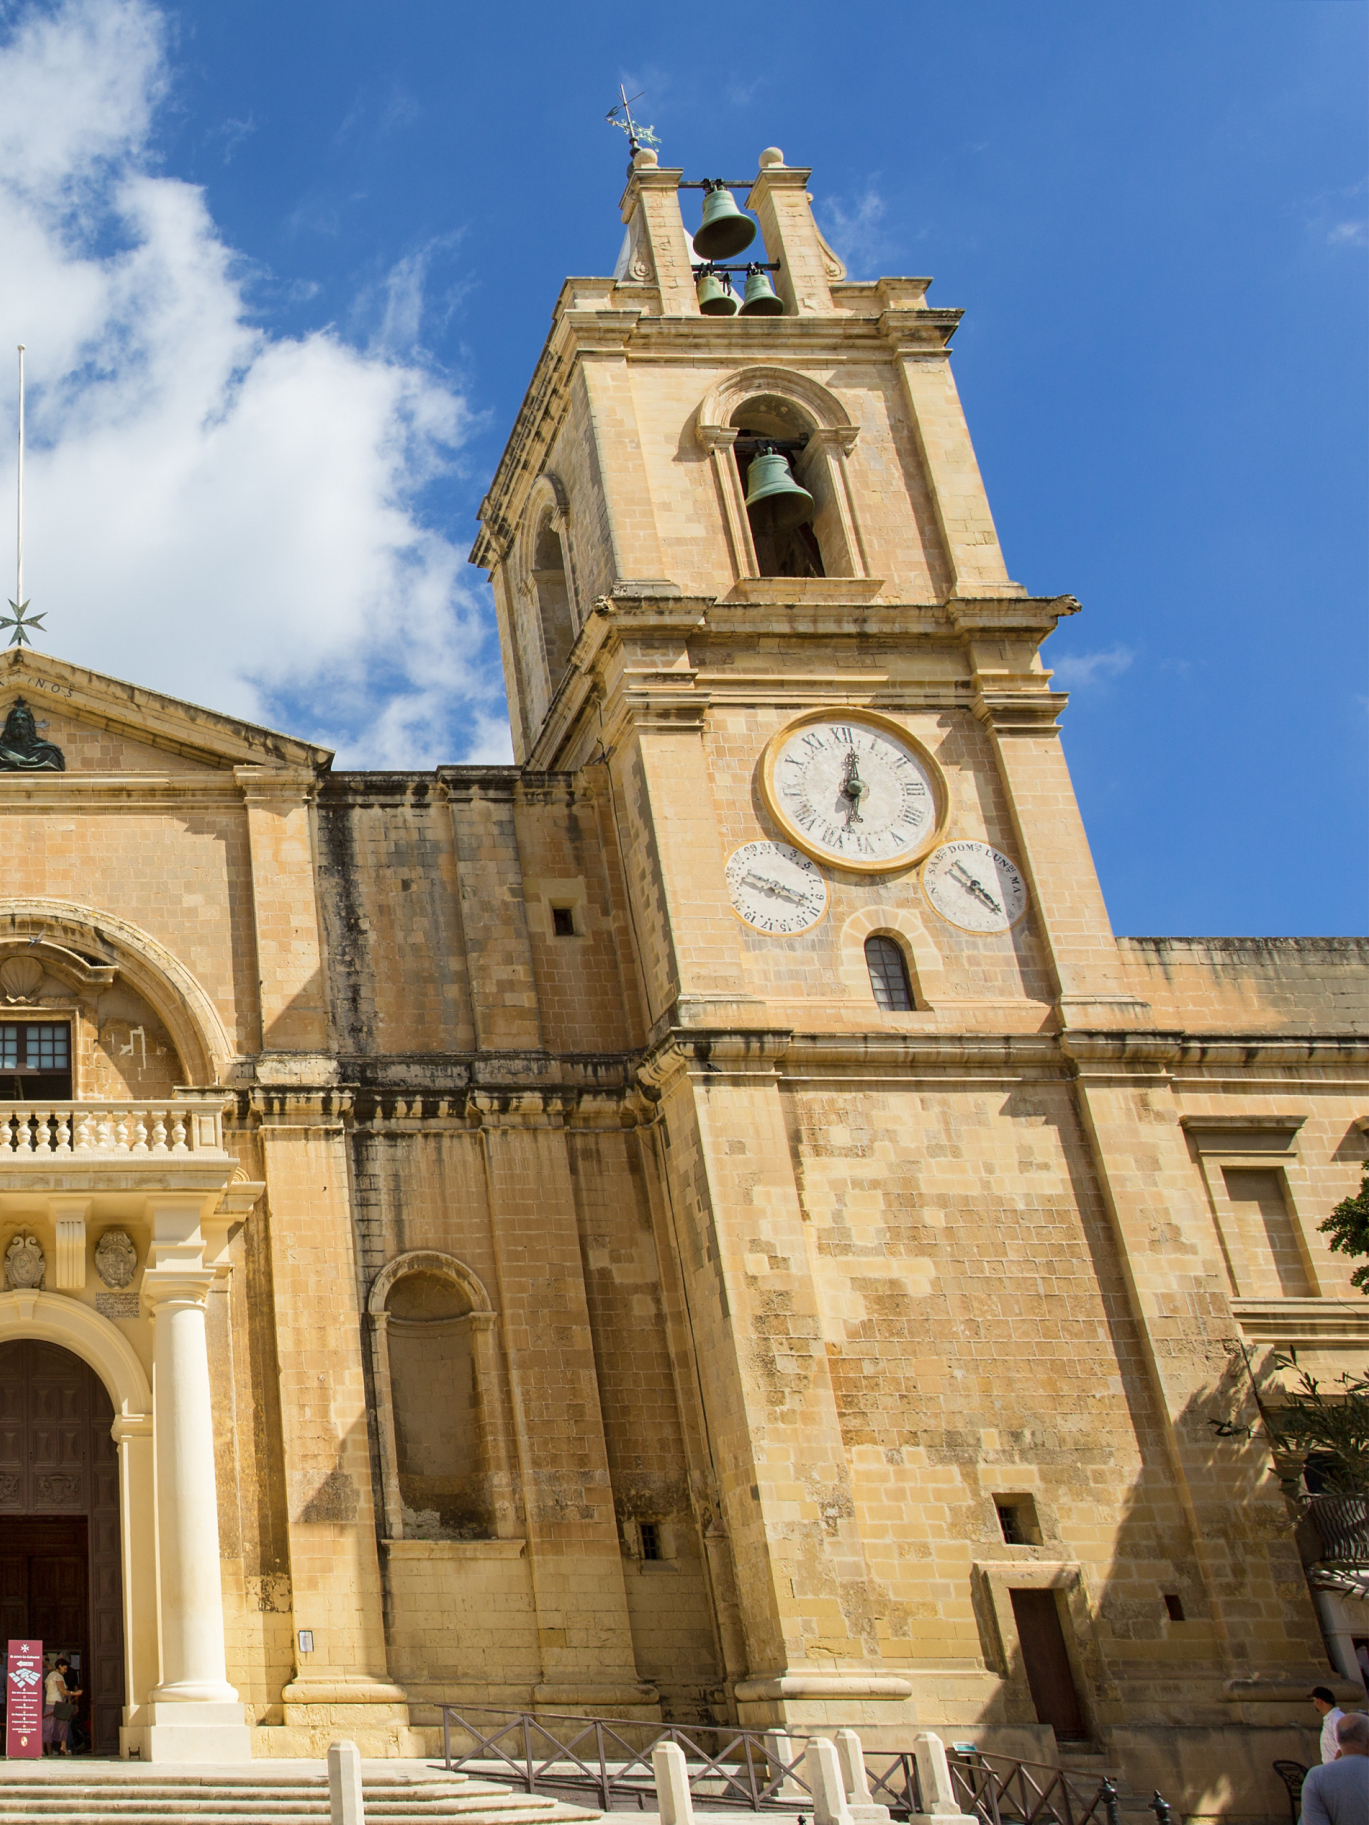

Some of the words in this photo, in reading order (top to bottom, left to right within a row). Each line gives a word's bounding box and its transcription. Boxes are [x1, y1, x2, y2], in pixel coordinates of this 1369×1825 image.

[35, 678, 73, 698] NOS
[801, 732, 825, 753] XI
[829, 727, 854, 744] XII
[870, 738, 878, 750] I
[784, 754, 805, 771] X
[895, 754, 911, 769] II
[905, 782, 925, 796] III
[890, 830, 907, 847] V
[803, 861, 813, 869] 5
